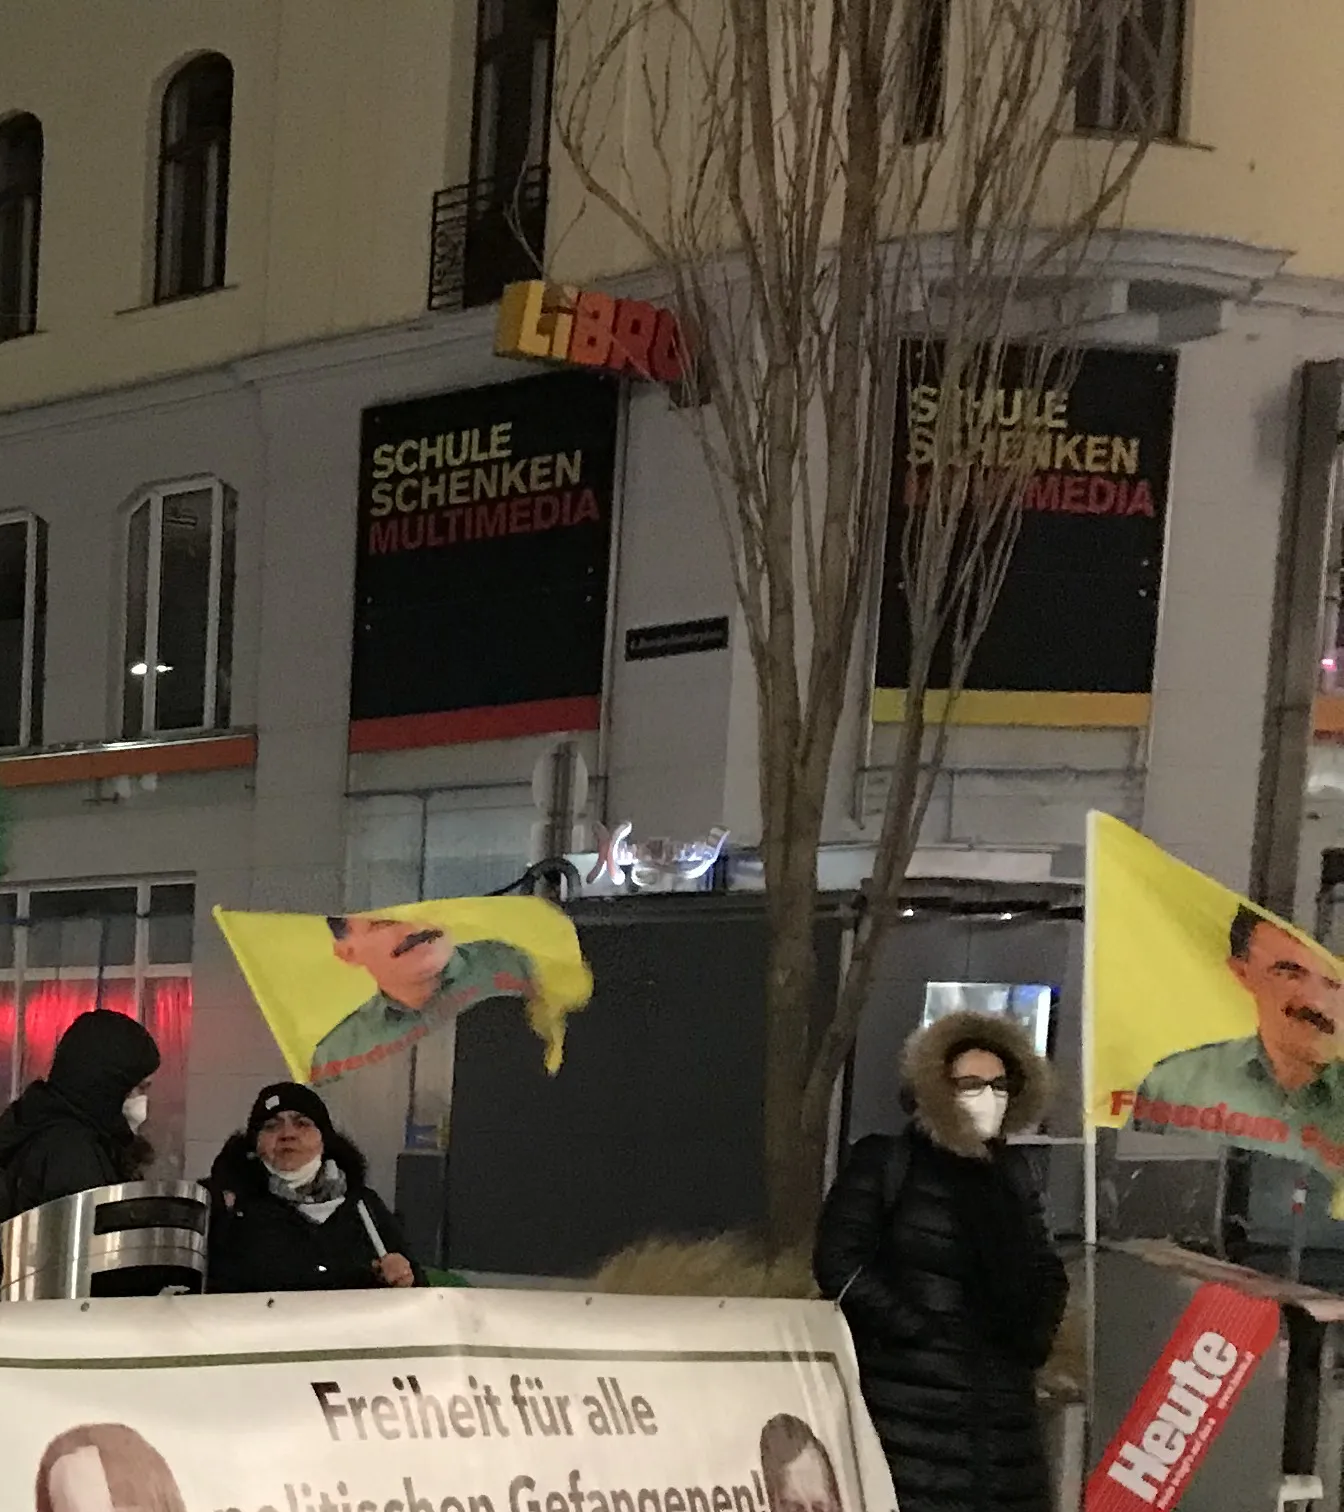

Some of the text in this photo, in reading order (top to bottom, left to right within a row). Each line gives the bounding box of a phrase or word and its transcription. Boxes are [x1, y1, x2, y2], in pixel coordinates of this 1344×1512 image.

[369, 449, 582, 517] SCHENKEN
[372, 421, 513, 479] SCHULE
[369, 488, 600, 556] MULTIMEDIA
[311, 1374, 658, 1443] Freiheit für alle
[1107, 1331, 1238, 1504] Heute
